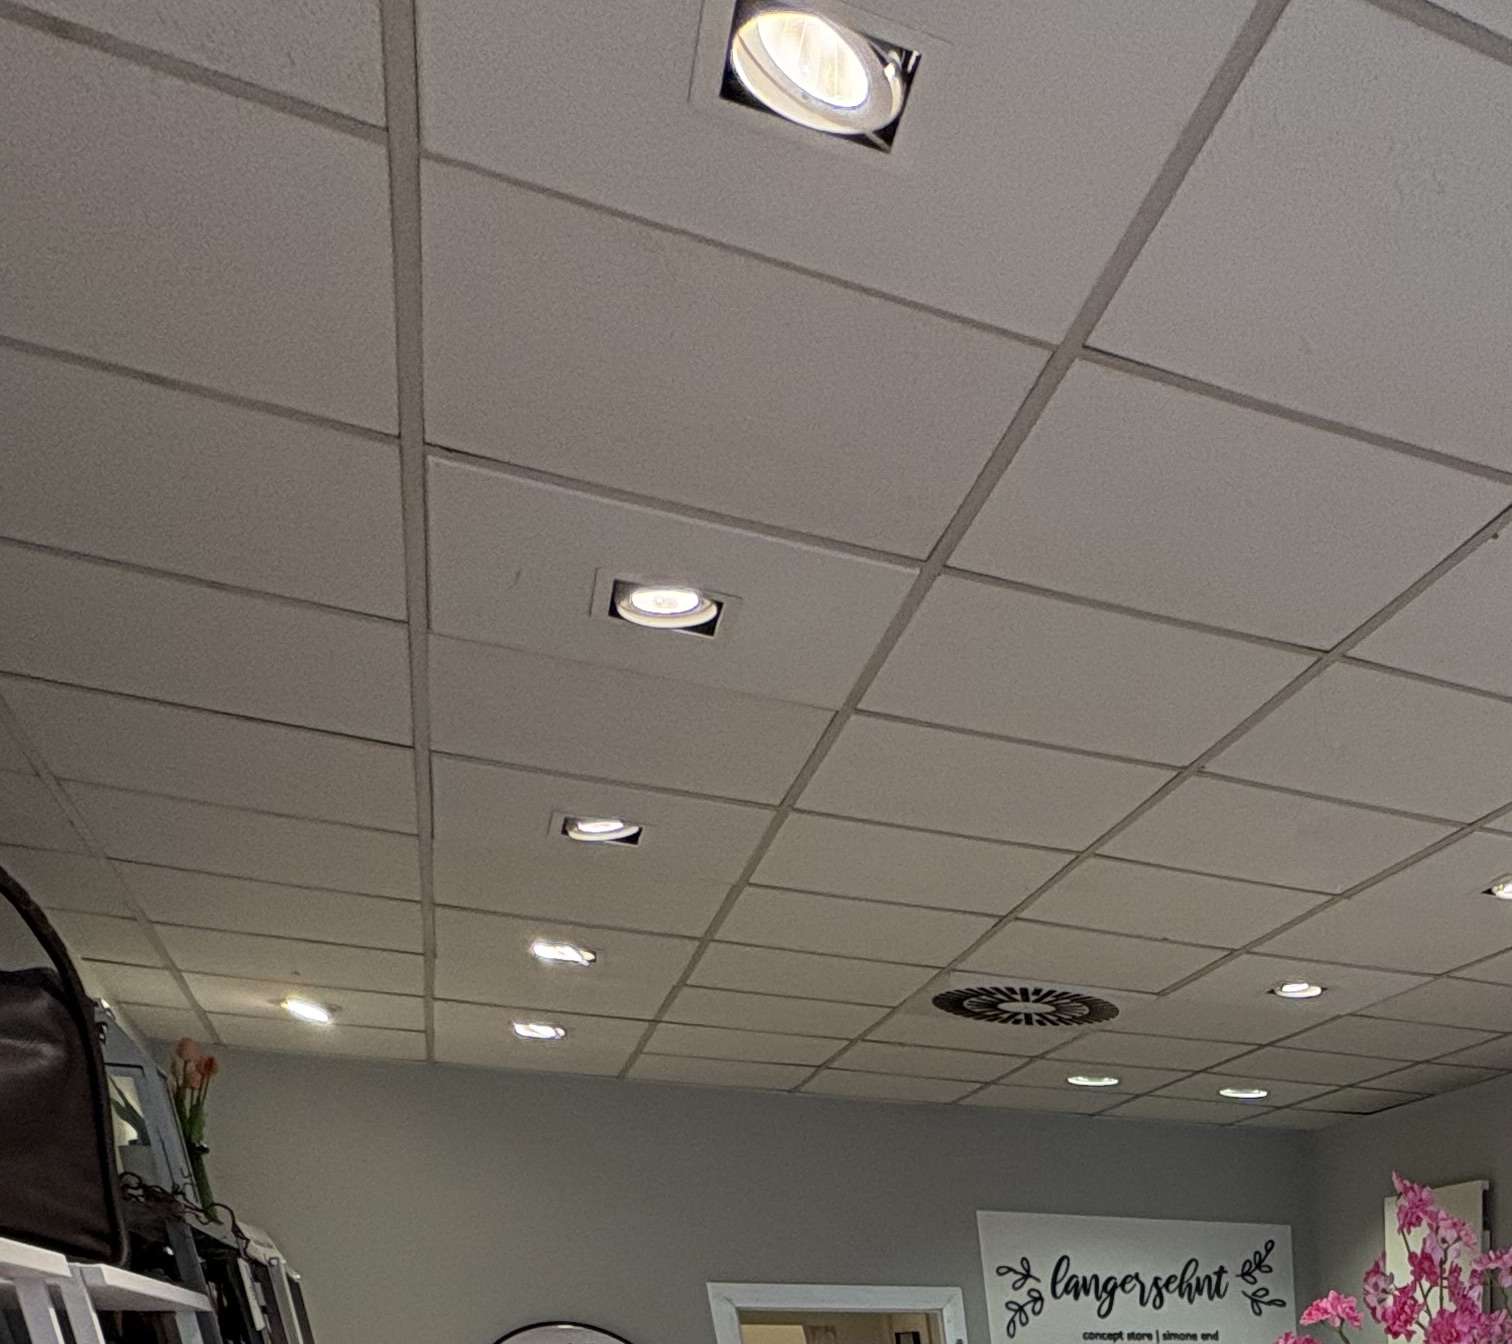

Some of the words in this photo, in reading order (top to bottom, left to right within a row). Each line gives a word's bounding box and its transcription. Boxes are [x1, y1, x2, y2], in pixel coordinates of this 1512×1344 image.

[1050, 1254, 1230, 1319] langersehnt
[1082, 1331, 1123, 1343] concept
[1126, 1331, 1153, 1341] store
[1162, 1330, 1198, 1341] simone
